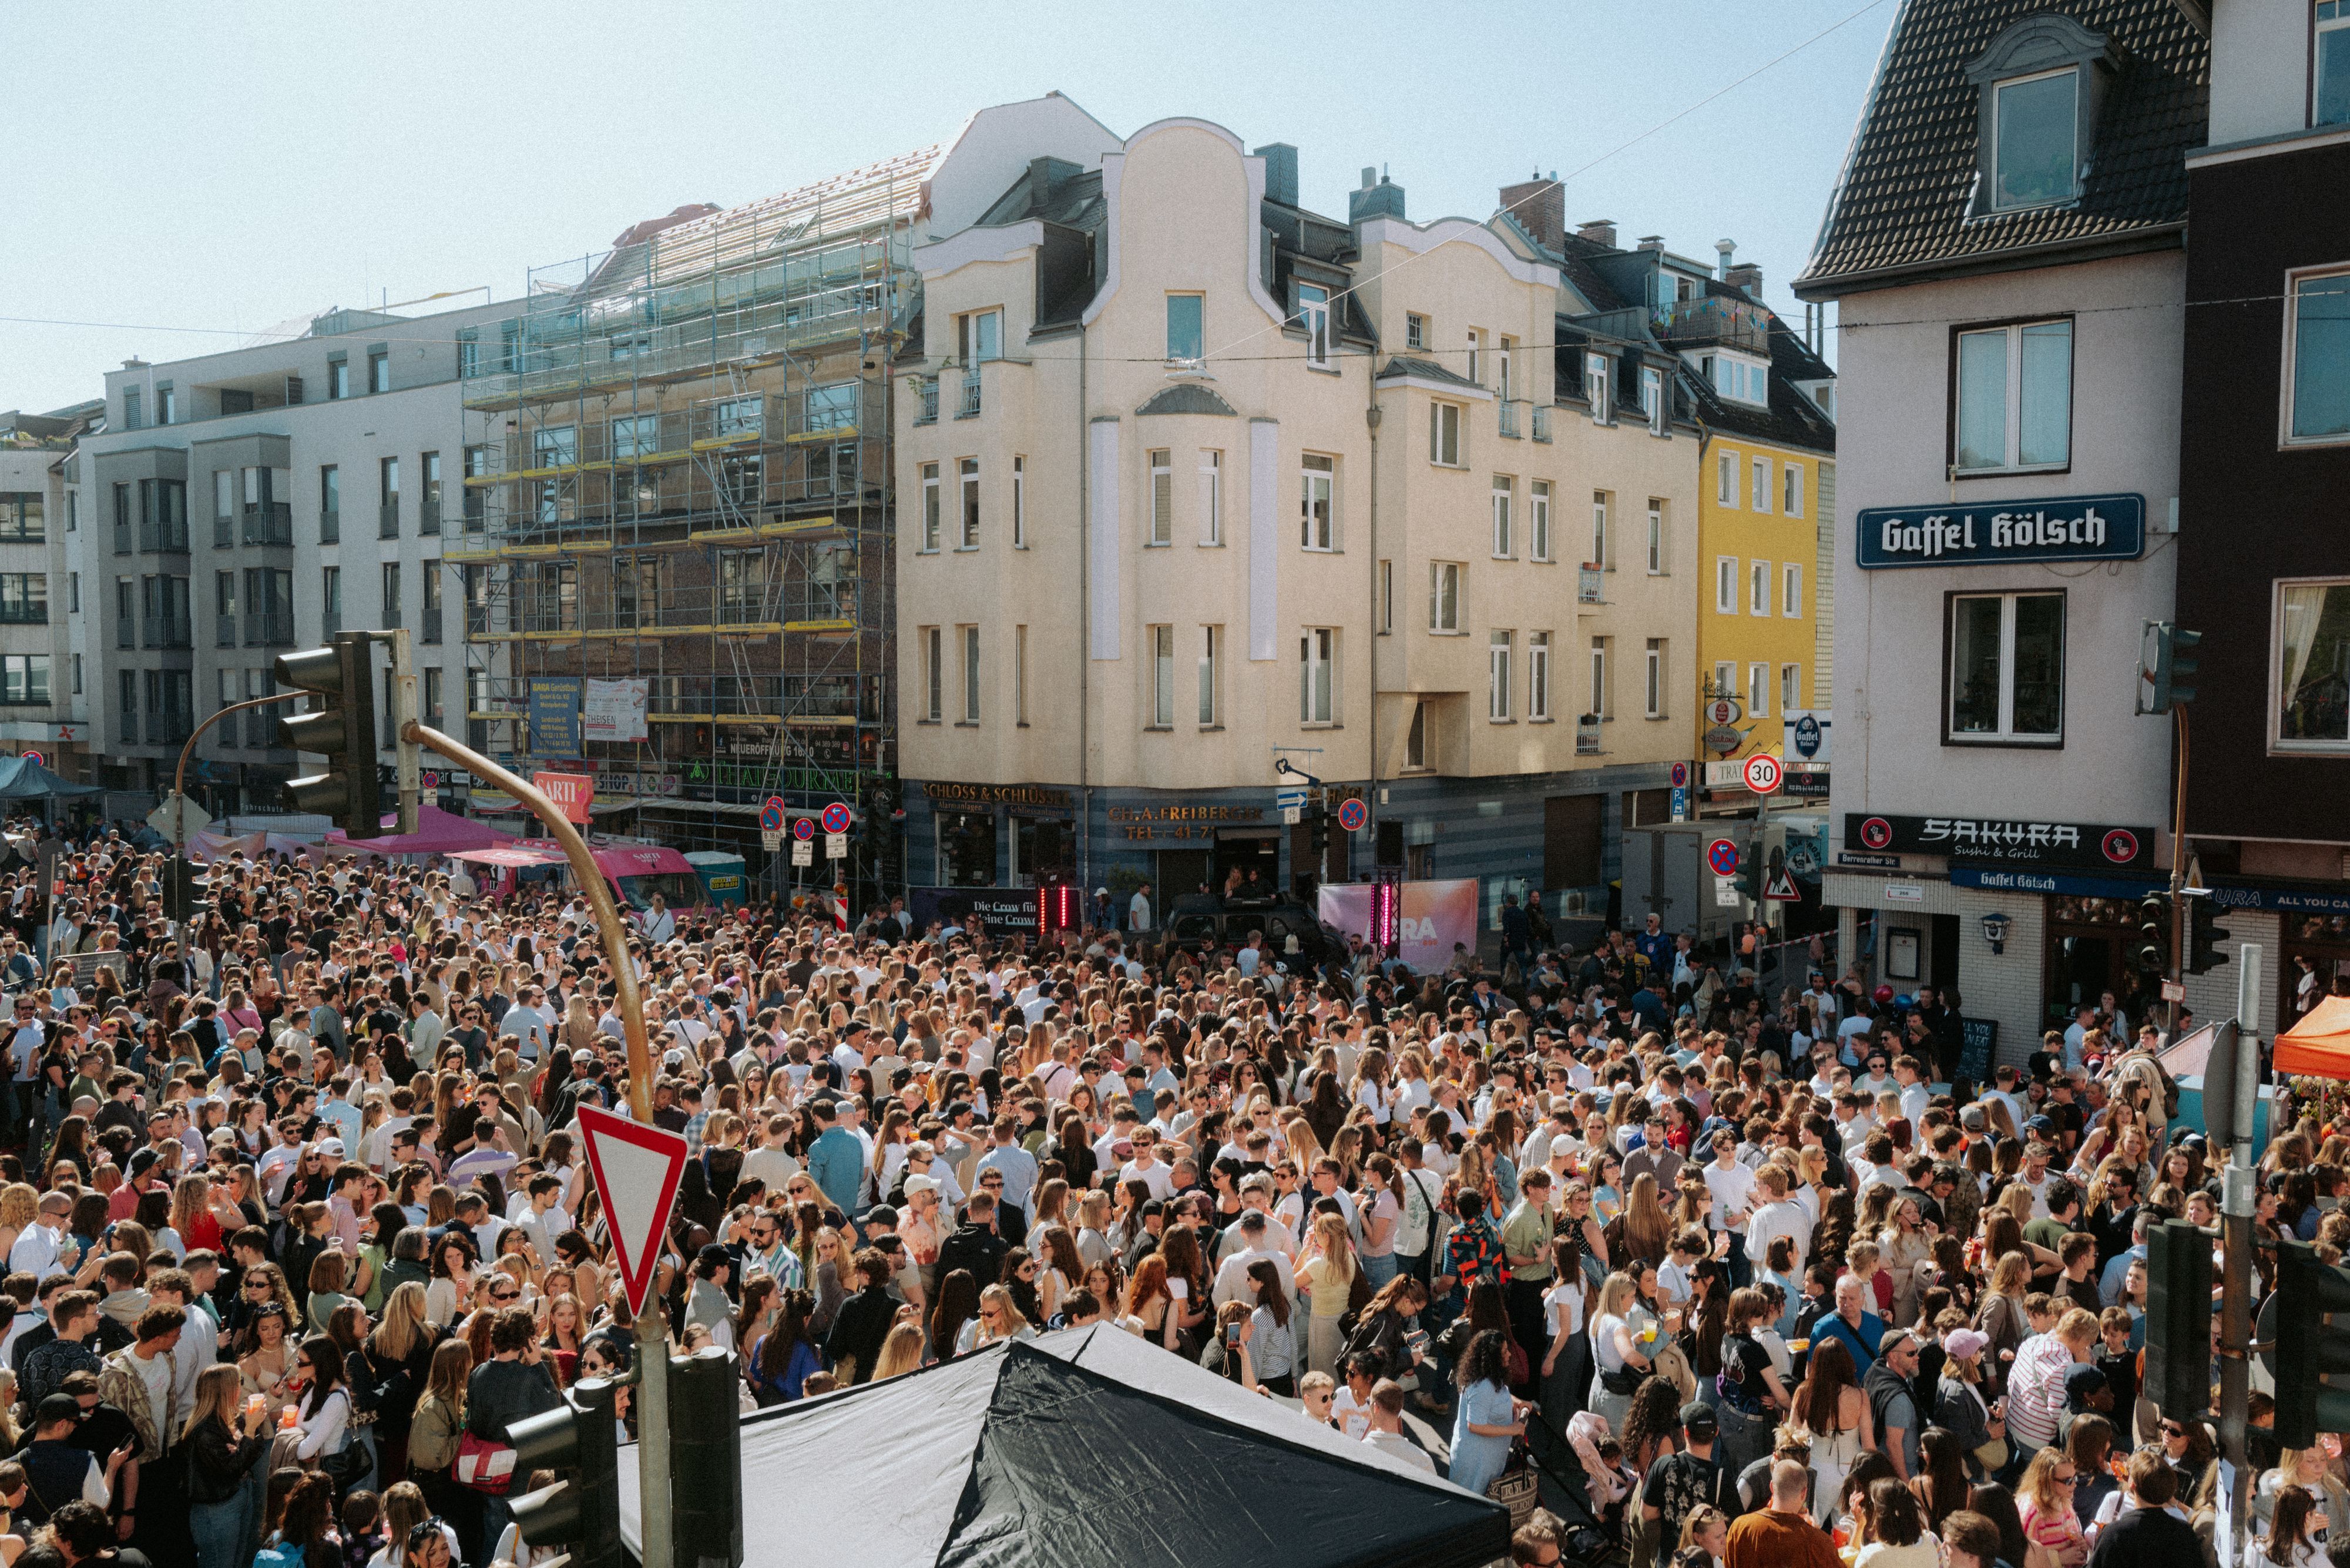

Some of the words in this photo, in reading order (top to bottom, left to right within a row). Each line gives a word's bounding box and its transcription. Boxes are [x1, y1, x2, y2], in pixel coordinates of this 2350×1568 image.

[1882, 514, 1978, 558] Gaffel
[1991, 507, 2106, 547] Kölsch
[532, 684, 549, 692] BARA
[550, 683, 577, 692] Gerüstbau
[587, 714, 616, 724] THEISEN
[1797, 731, 1819, 741] Gaffel
[1752, 765, 1774, 782] 30
[922, 784, 975, 800] SCHLOSS
[981, 787, 990, 800] &
[240, 803, 283, 813] Fahrschule
[938, 801, 982, 811] Alarmanlagen
[1919, 818, 2080, 849] SAKURA
[1955, 844, 1991, 857] Sushi
[1993, 848, 2003, 857] &
[2007, 848, 2040, 859] Grill
[1842, 854, 1883, 864] Berrenrather
[1885, 857, 1896, 865] Str.
[1981, 872, 2015, 887] Gaffel
[2017, 874, 2055, 891] Kölsch
[974, 901, 991, 911] Die
[993, 901, 1019, 911] Crow
[2277, 897, 2299, 905] ALL
[2304, 898, 2328, 907] YOU
[2332, 899, 2349, 908] CA
